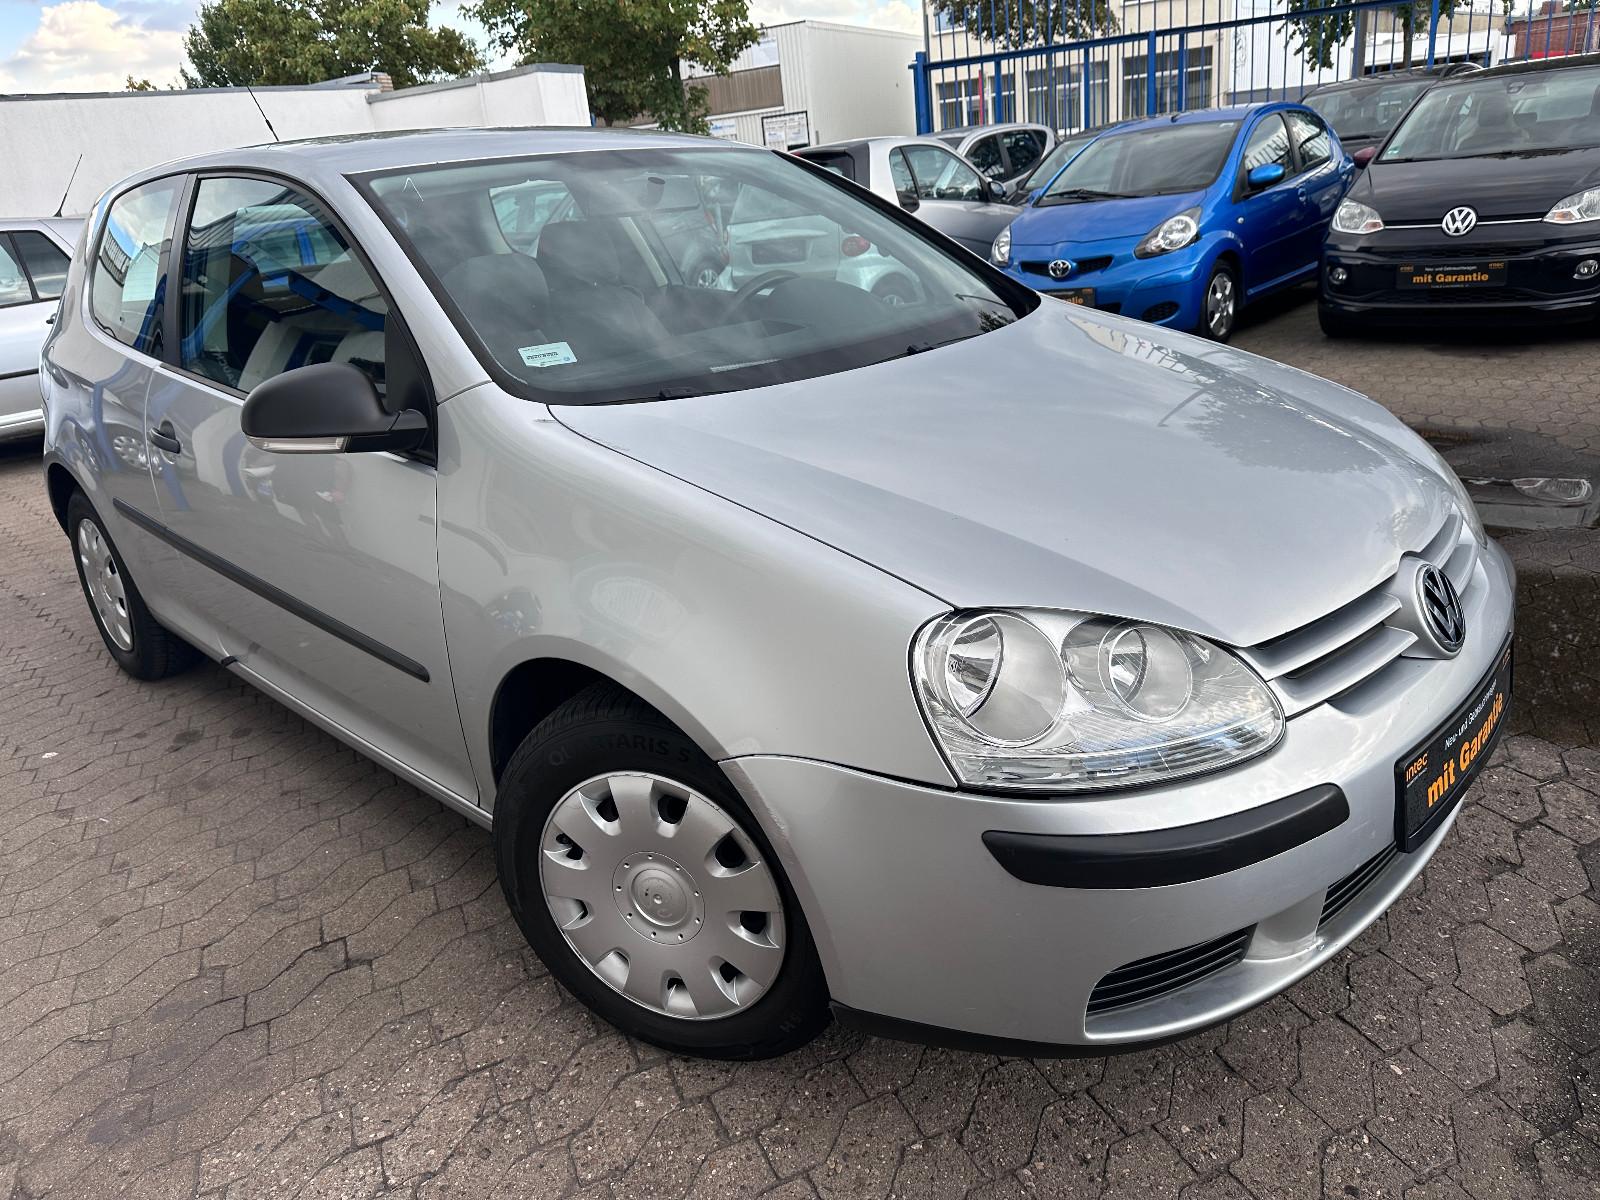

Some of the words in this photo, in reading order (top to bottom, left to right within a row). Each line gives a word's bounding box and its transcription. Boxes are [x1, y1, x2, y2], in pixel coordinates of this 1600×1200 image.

[1412, 274, 1432, 284] mit
[1435, 272, 1489, 284] Garantie
[1428, 758, 1456, 808] mit
[1460, 691, 1504, 773] Garantie
